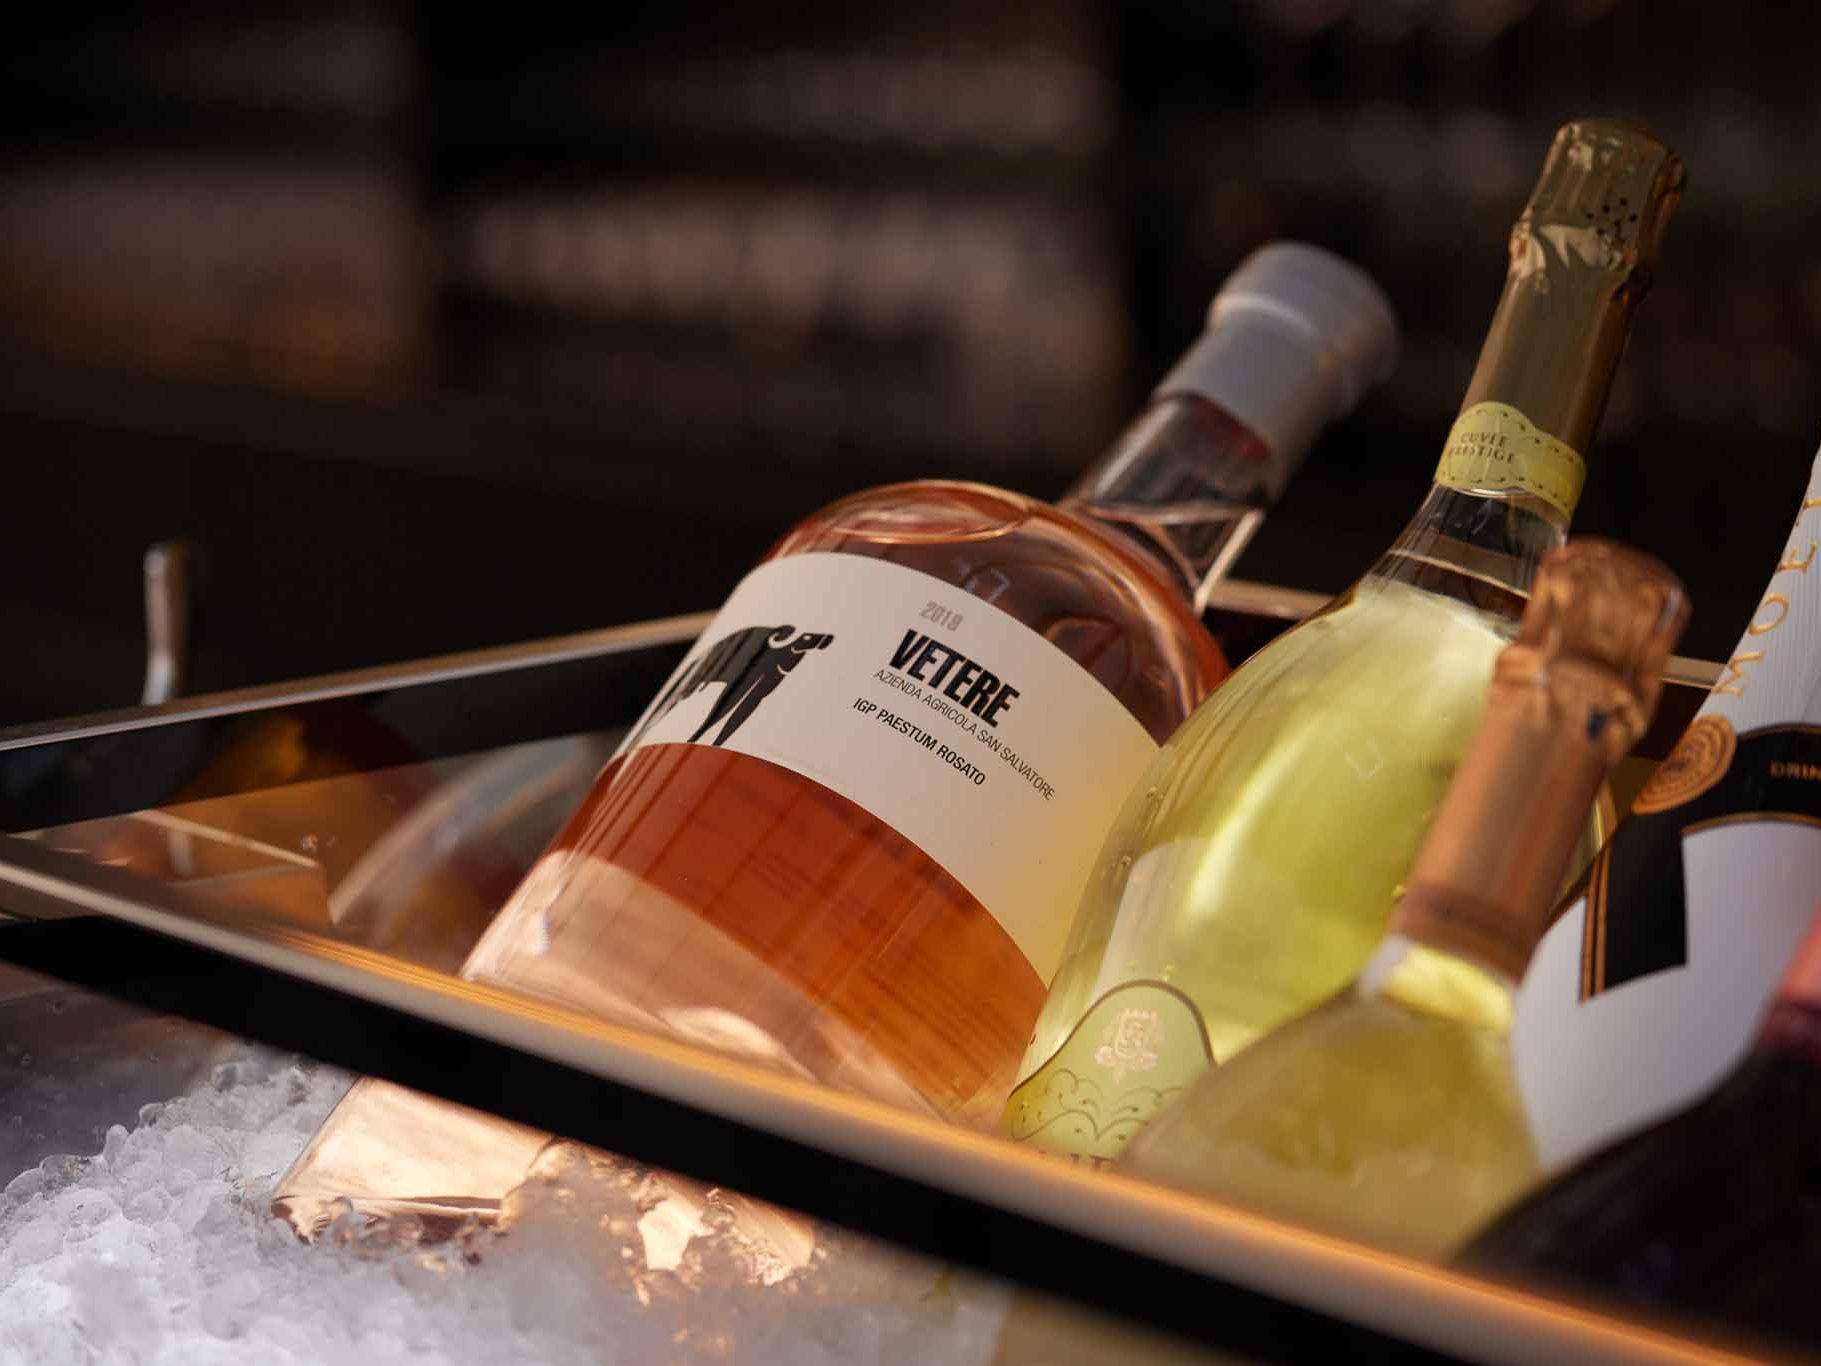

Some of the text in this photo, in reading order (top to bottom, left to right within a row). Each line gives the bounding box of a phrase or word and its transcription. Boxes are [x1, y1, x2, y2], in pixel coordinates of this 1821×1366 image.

[919, 601, 964, 632] 2019
[889, 628, 1021, 729] VETERE
[853, 697, 986, 786] IGP PAESTUM ROSATO
[873, 669, 1056, 801] AZIENDA AGRICOLA SAN SALVATORE
